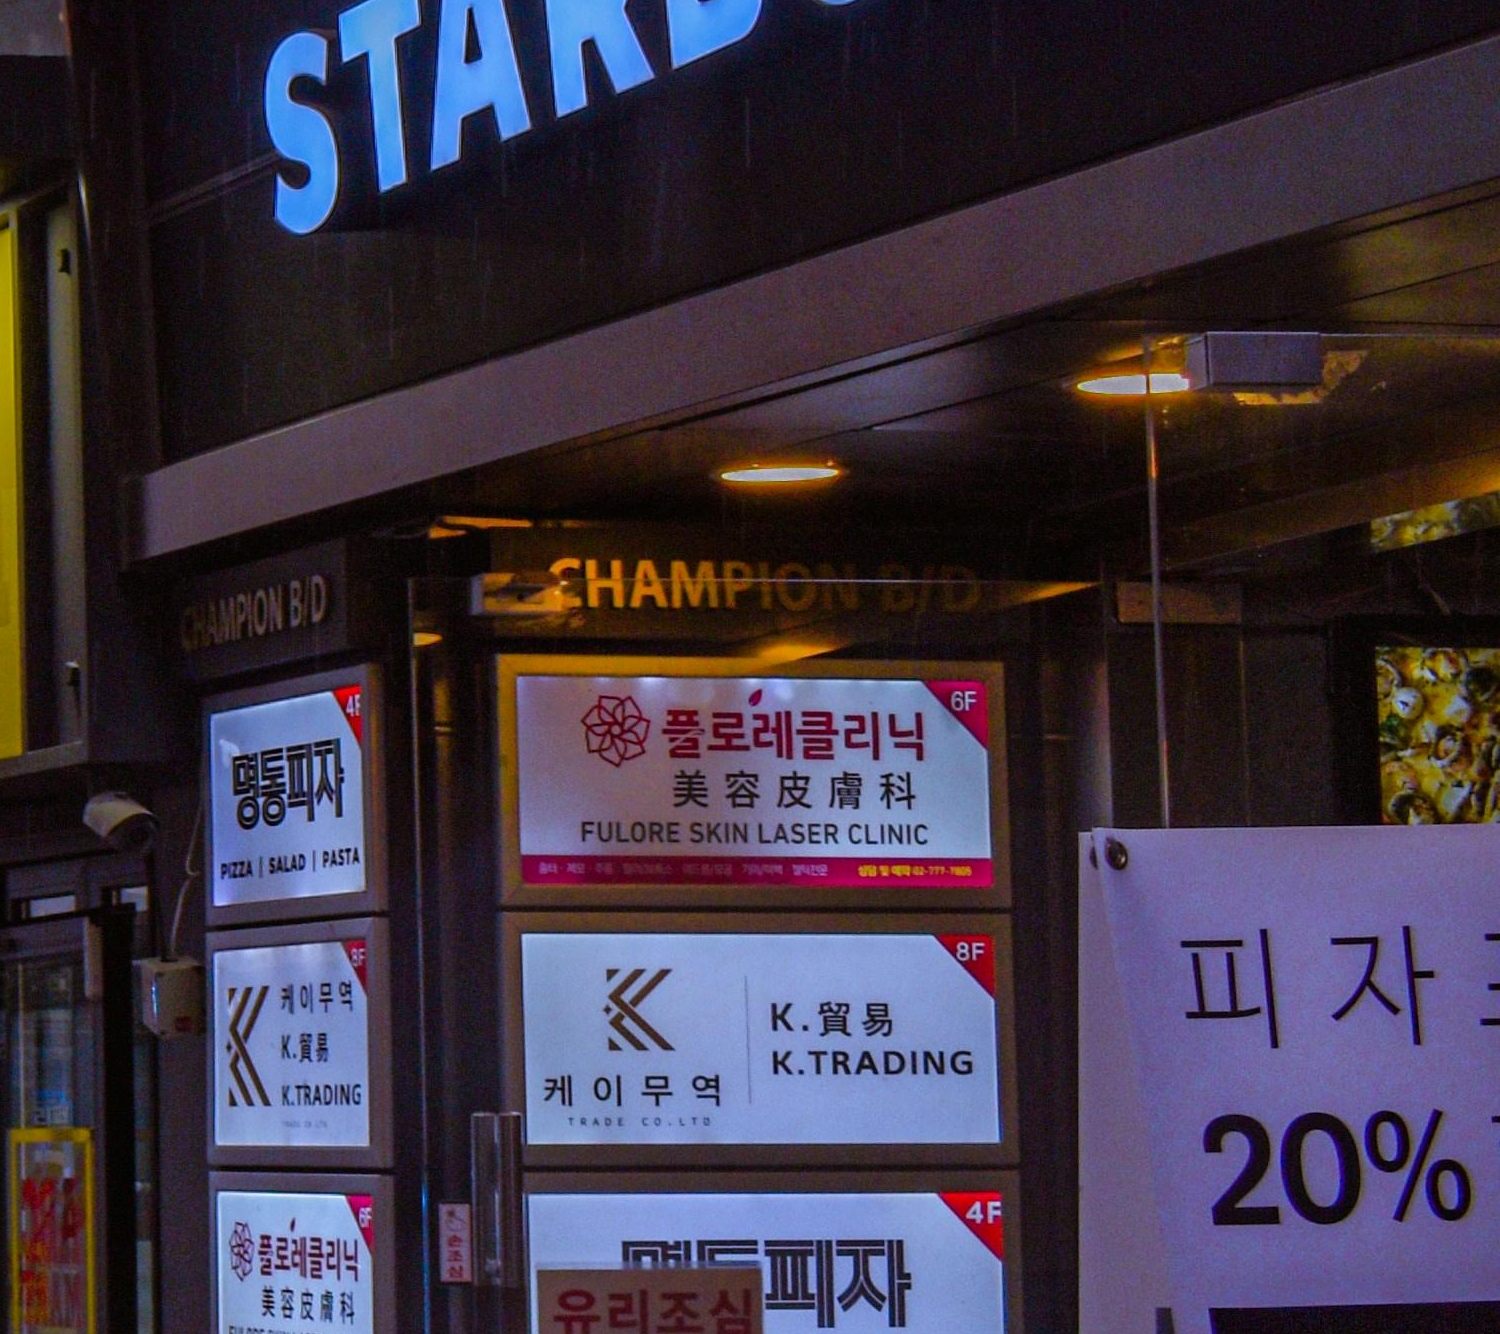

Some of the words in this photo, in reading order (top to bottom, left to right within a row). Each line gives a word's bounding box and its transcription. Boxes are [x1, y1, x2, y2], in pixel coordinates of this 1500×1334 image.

[180, 584, 285, 652] CHAMPION
[950, 690, 979, 712] 6F
[660, 708, 926, 763] 플로레클리닉
[231, 737, 346, 832] 명동피자
[672, 770, 918, 811] 美容皮膚科
[580, 820, 682, 849] FULORE
[689, 821, 751, 848] SKIN
[758, 821, 840, 848] LASER
[847, 821, 930, 848] CLINIC
[220, 860, 254, 880] PIZZA
[268, 854, 306, 874] SALAD
[321, 845, 361, 869] PASTA
[956, 942, 985, 963] 8F
[771, 1049, 975, 1077] K.TRADING
[281, 1081, 362, 1108] K.TRADING
[1202, 1107, 1472, 1226] 20%
[965, 1201, 1003, 1224] 4F
